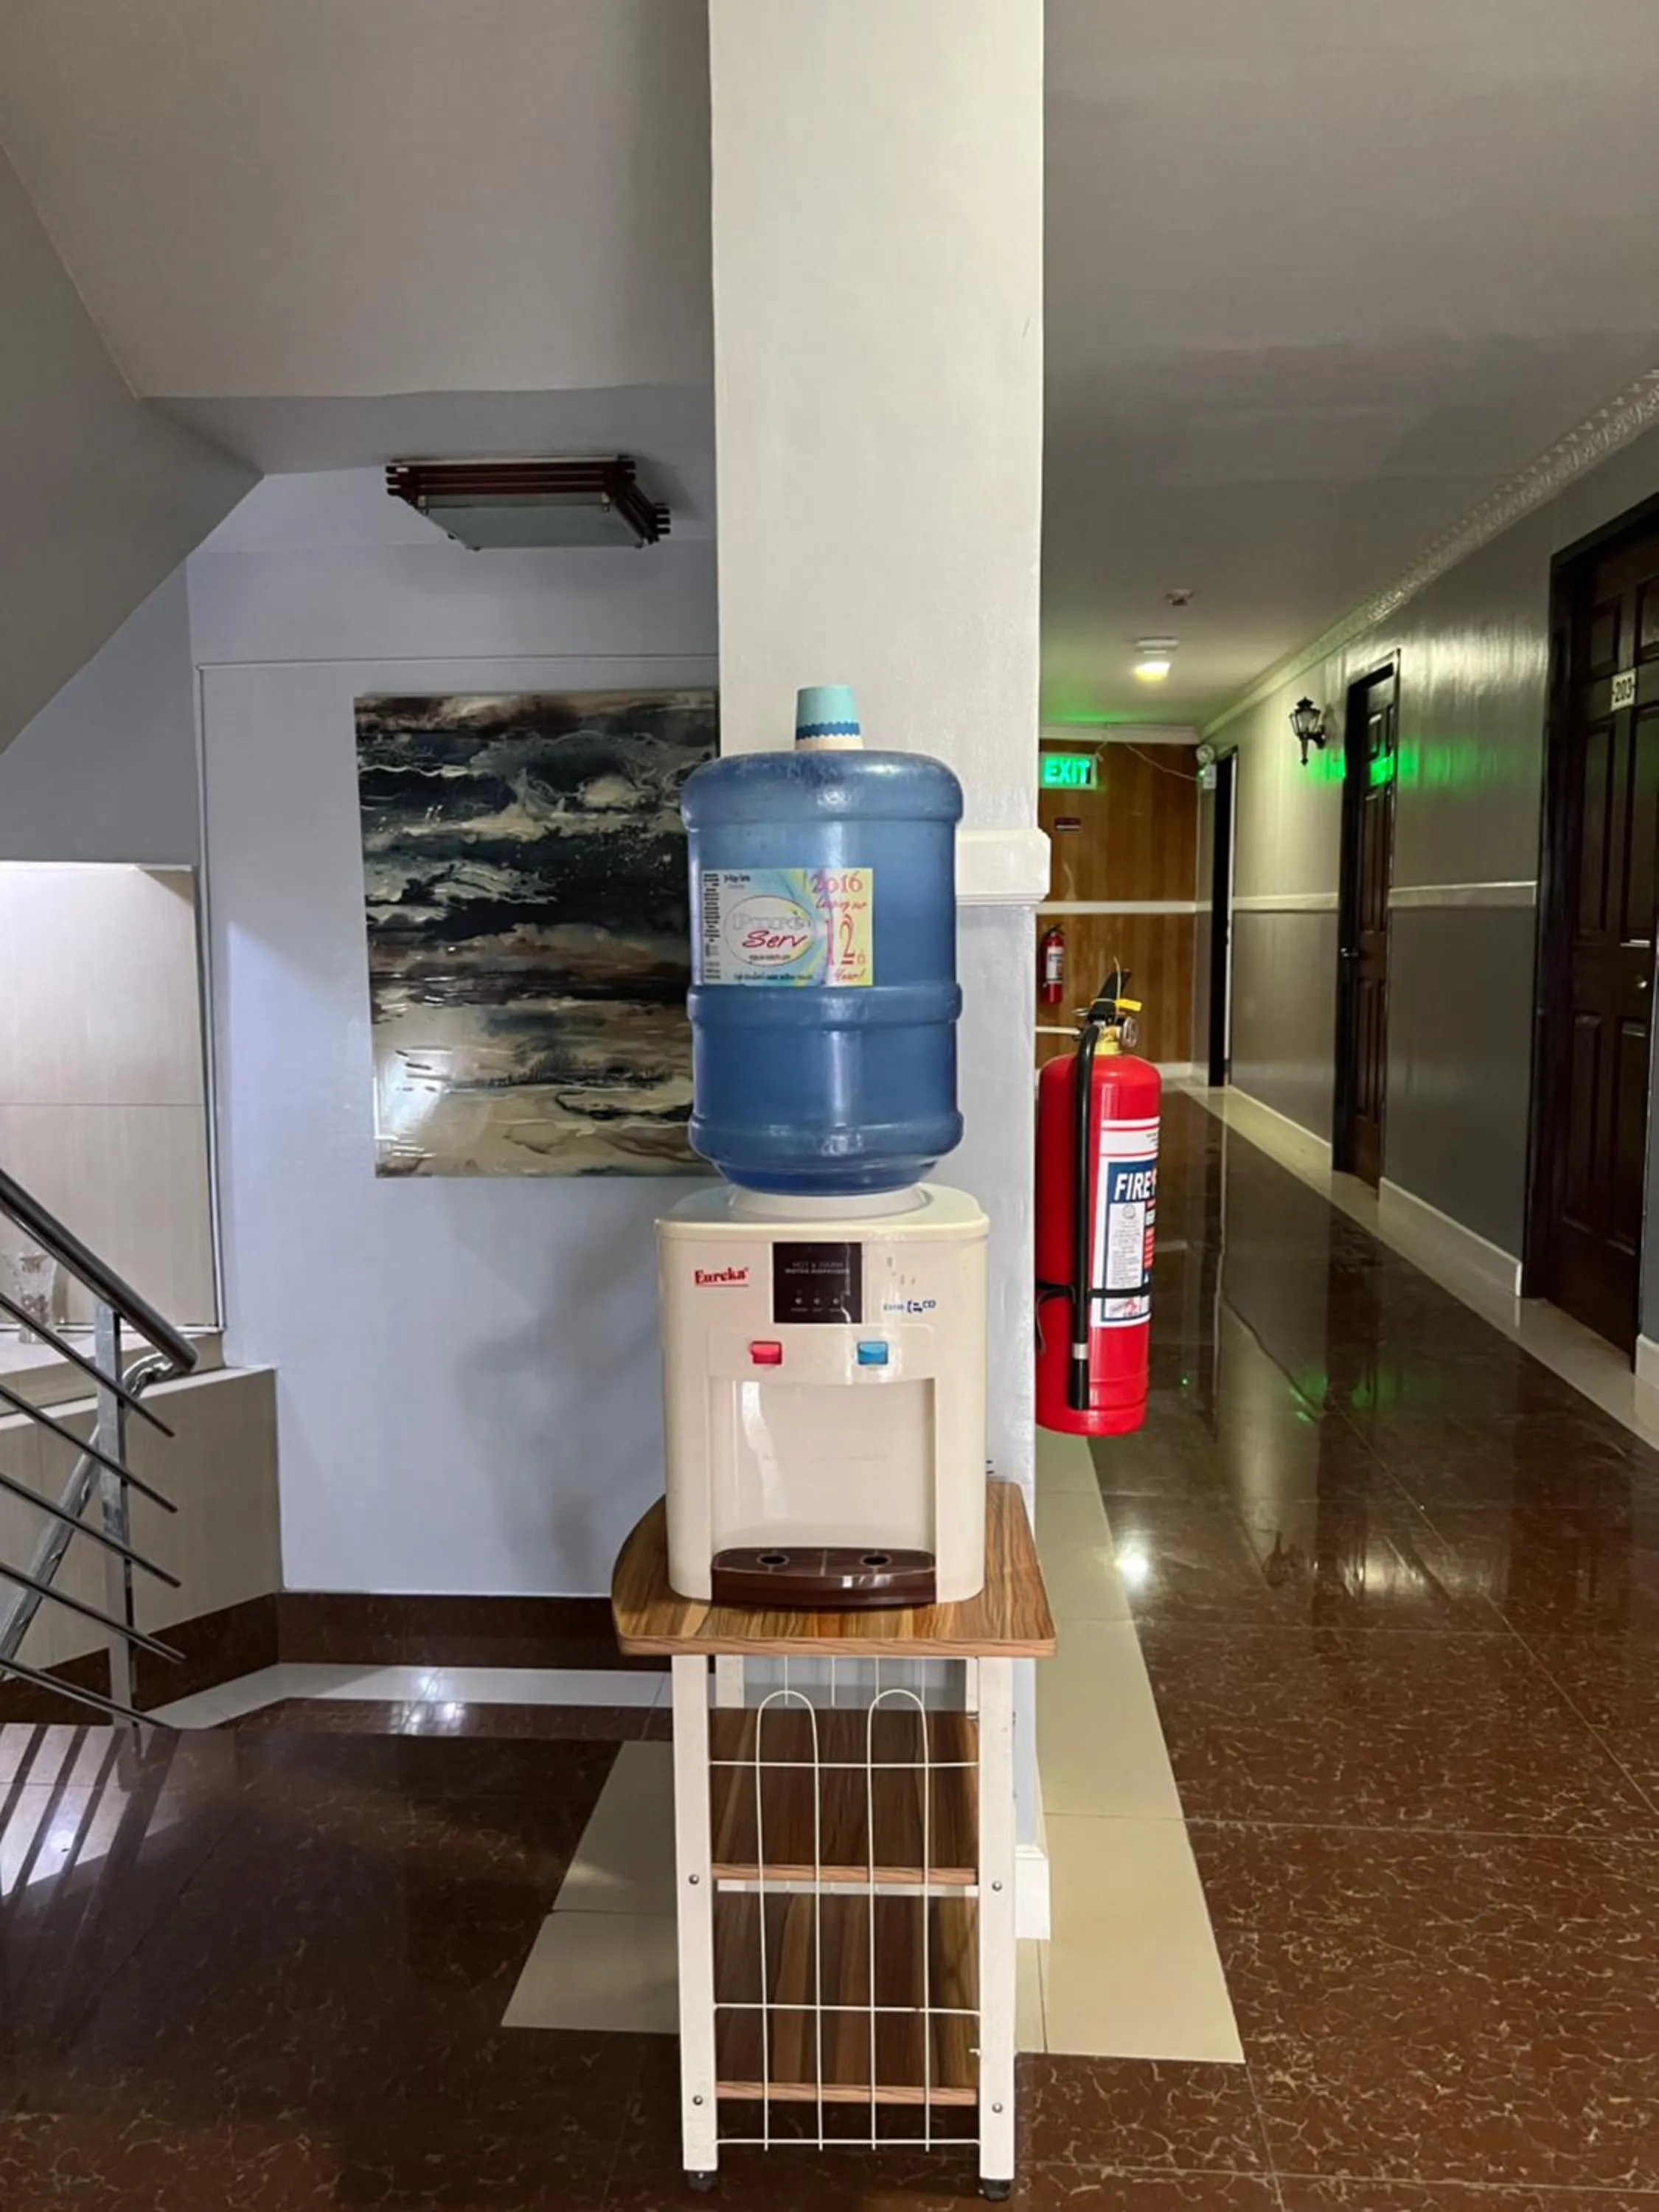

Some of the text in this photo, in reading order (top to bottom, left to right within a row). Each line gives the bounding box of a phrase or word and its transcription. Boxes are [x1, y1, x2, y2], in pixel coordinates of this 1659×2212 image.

[1044, 759, 1091, 784] EXIT
[810, 870, 863, 894] 2016
[742, 930, 808, 949] Serv
[1113, 1171, 1152, 1201] FIRE
[695, 1266, 746, 1284] Eureka
